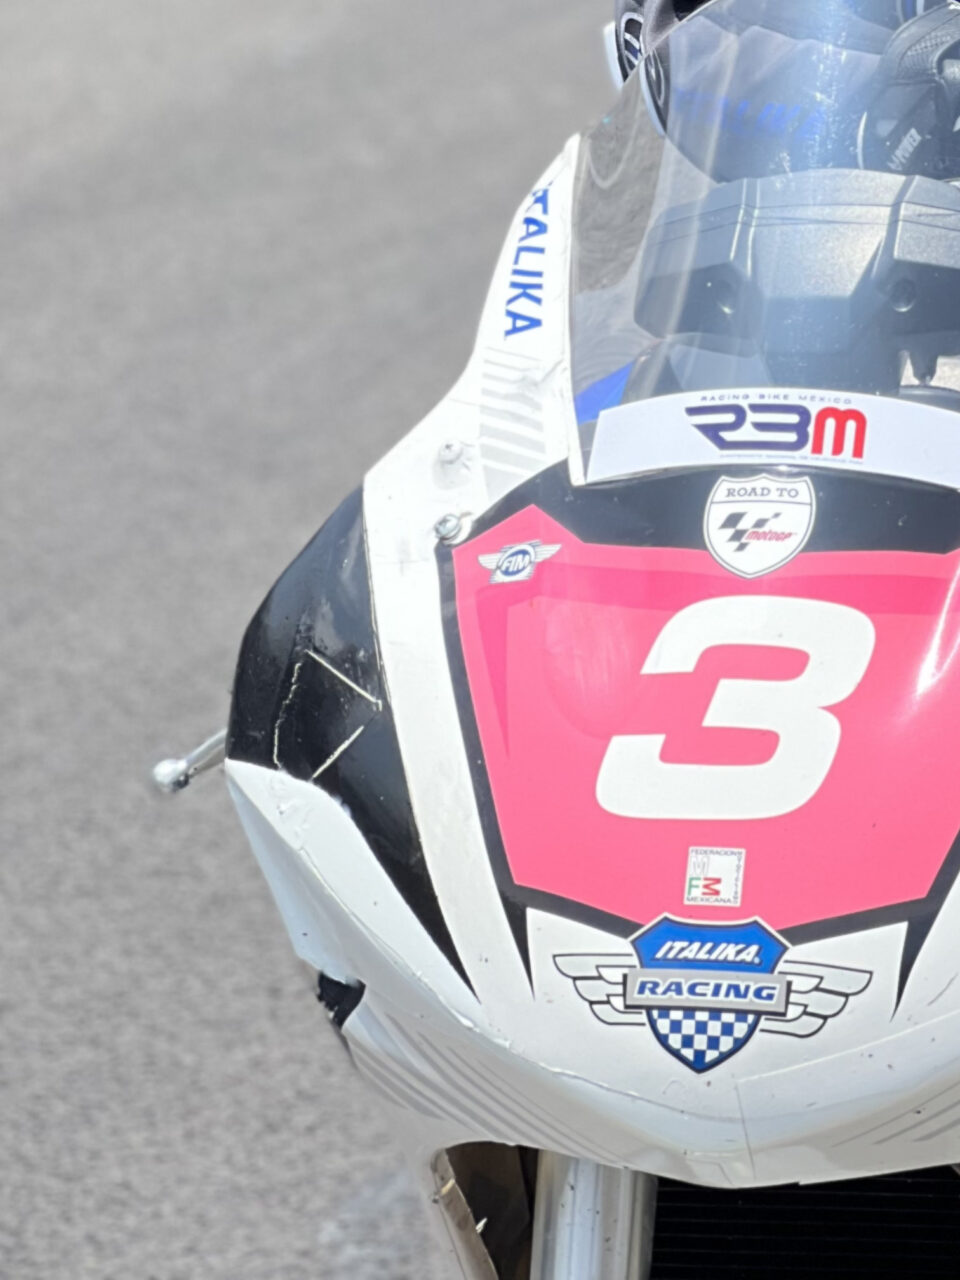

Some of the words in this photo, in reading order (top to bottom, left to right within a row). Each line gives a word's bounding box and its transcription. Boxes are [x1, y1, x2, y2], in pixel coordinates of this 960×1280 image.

[700, 393, 750, 402] RACING
[758, 393, 790, 401] BIKE
[725, 487, 771, 498] ROAD
[776, 487, 800, 499] TO
[500, 552, 531, 573] FIM
[594, 594, 877, 821] 3
[654, 940, 758, 964] ITALIKA
[637, 980, 777, 1002] RACING
